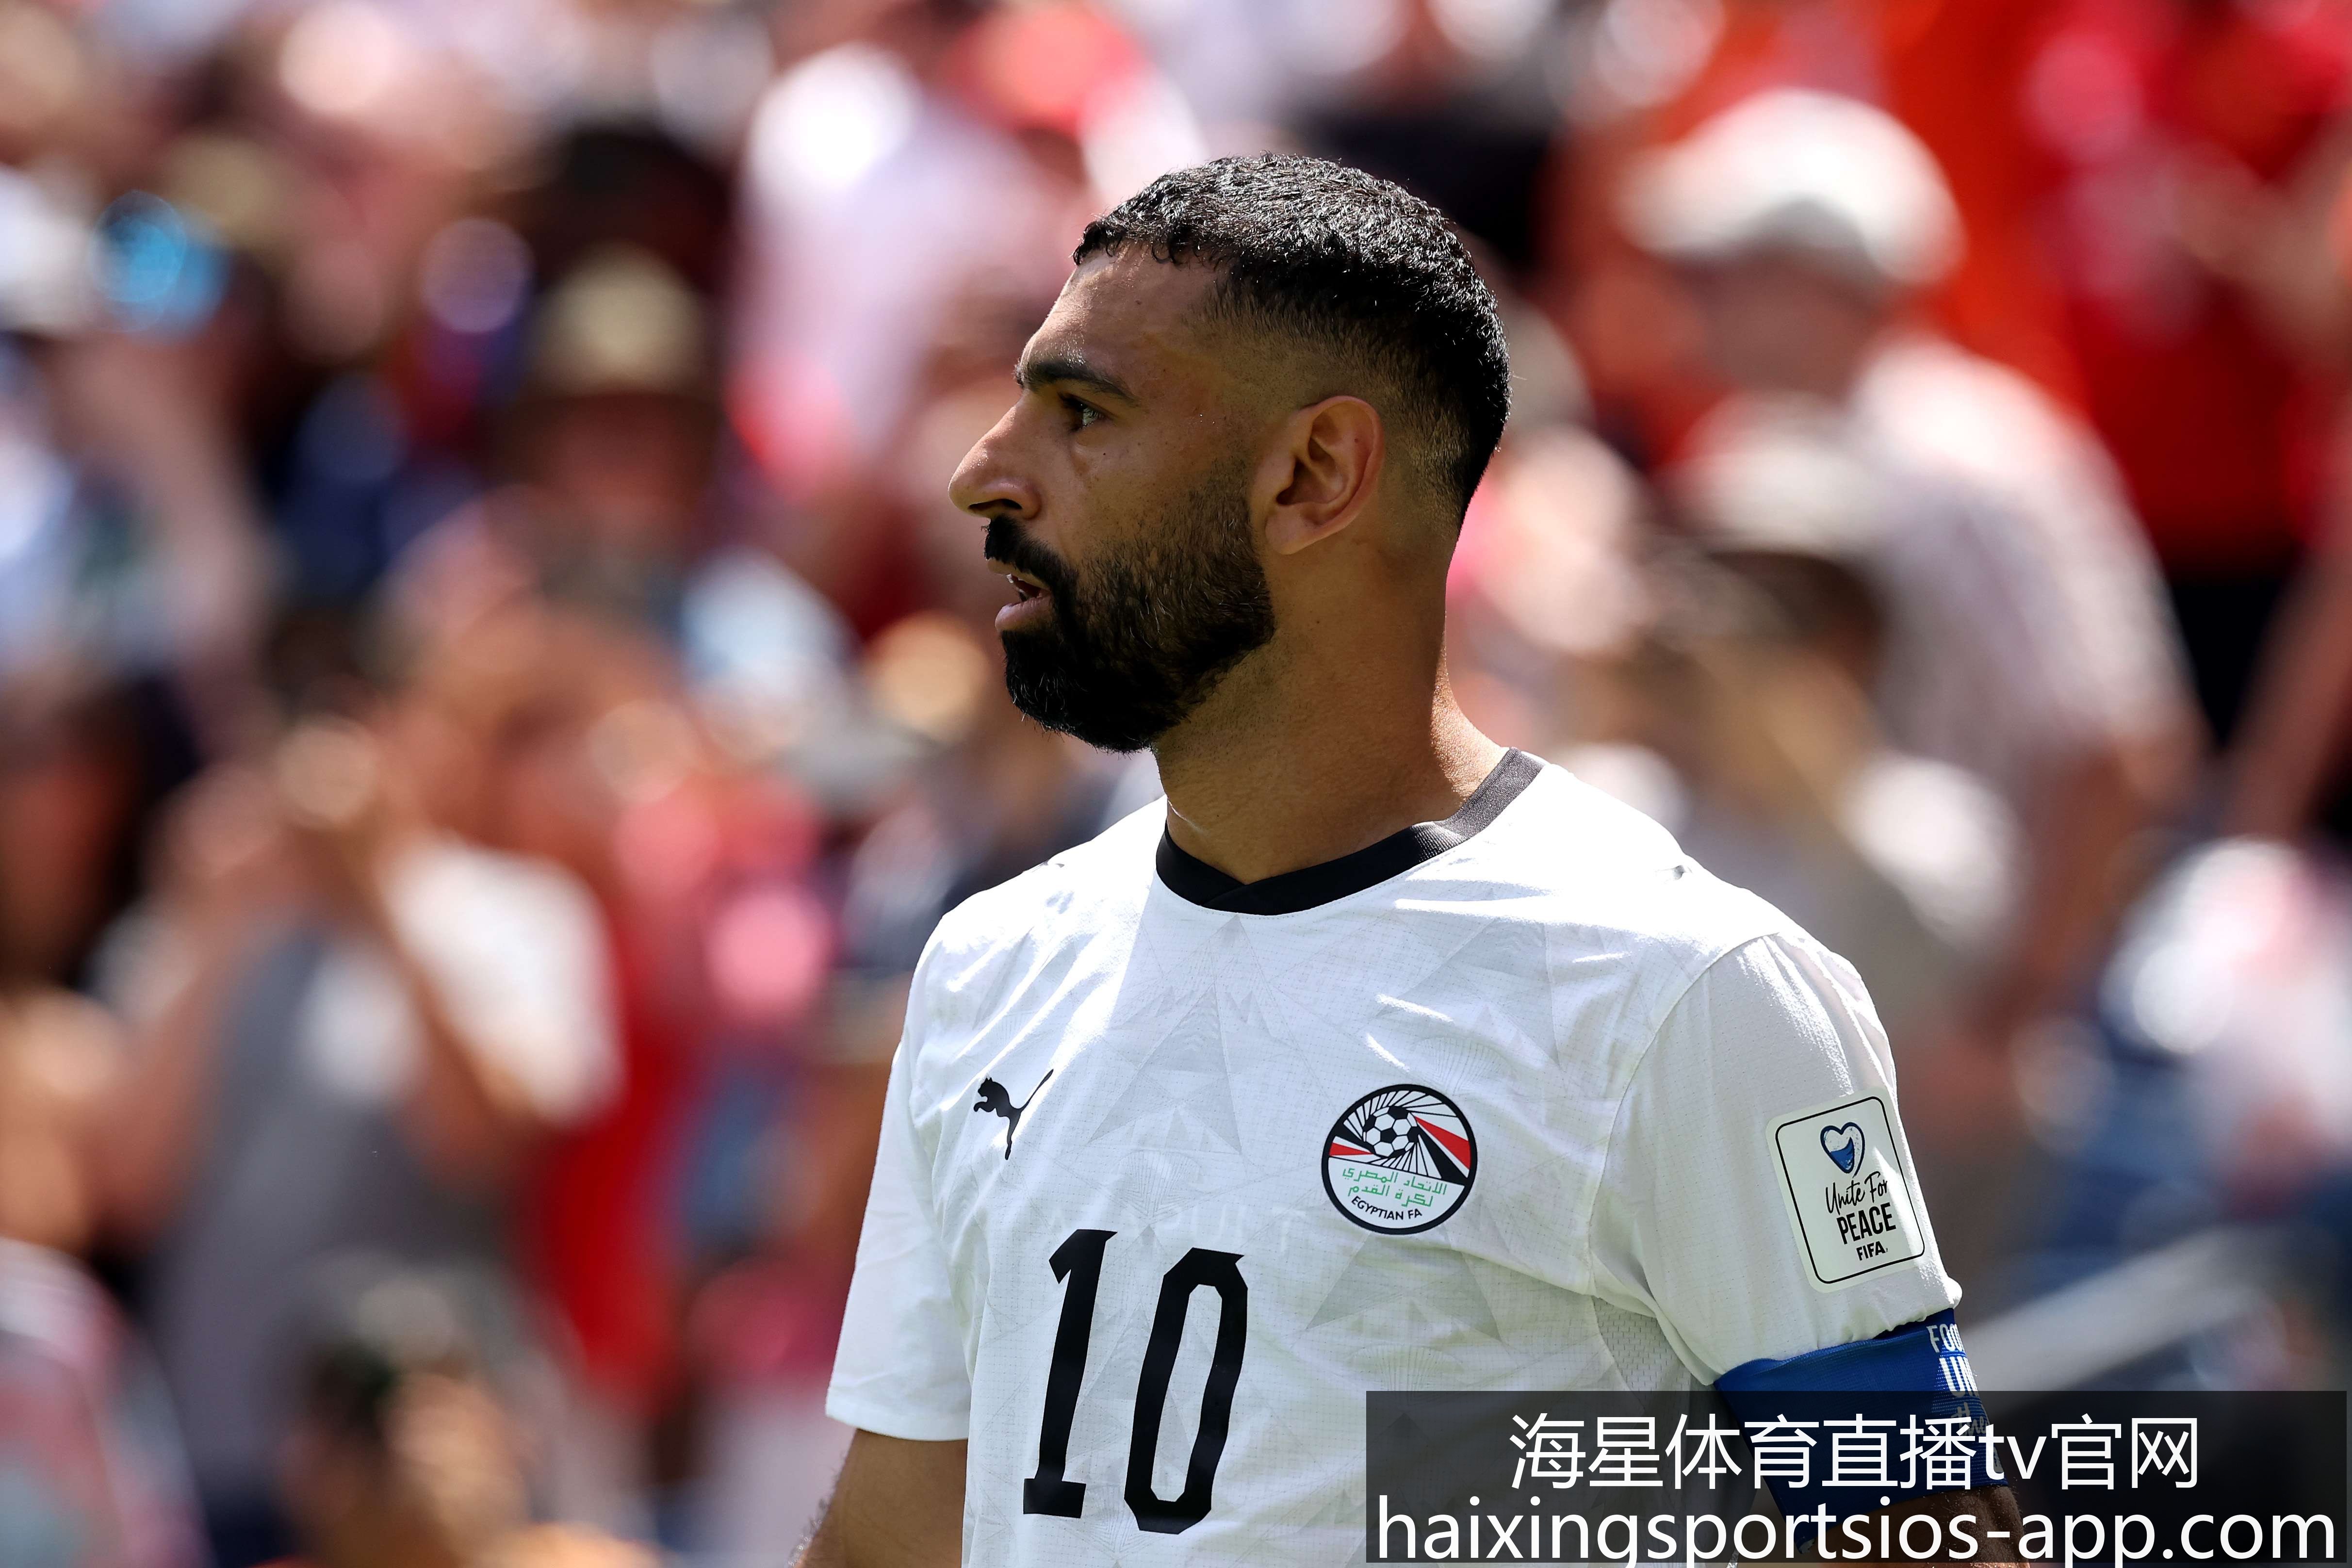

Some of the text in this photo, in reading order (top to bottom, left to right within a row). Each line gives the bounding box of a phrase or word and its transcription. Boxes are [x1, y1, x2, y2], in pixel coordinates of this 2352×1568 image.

[1342, 1168, 1447, 1195] الاتحاد المصري
[1348, 1184, 1433, 1207] لكرة القدم
[1825, 1171, 1888, 1215] Unite For
[1351, 1196, 1422, 1220] EGYPTIAN FA
[1836, 1202, 1896, 1244] PEACE
[1856, 1241, 1886, 1261] FIFA
[1926, 1323, 1965, 1353] FOO
[1023, 1229, 1248, 1535] 10
